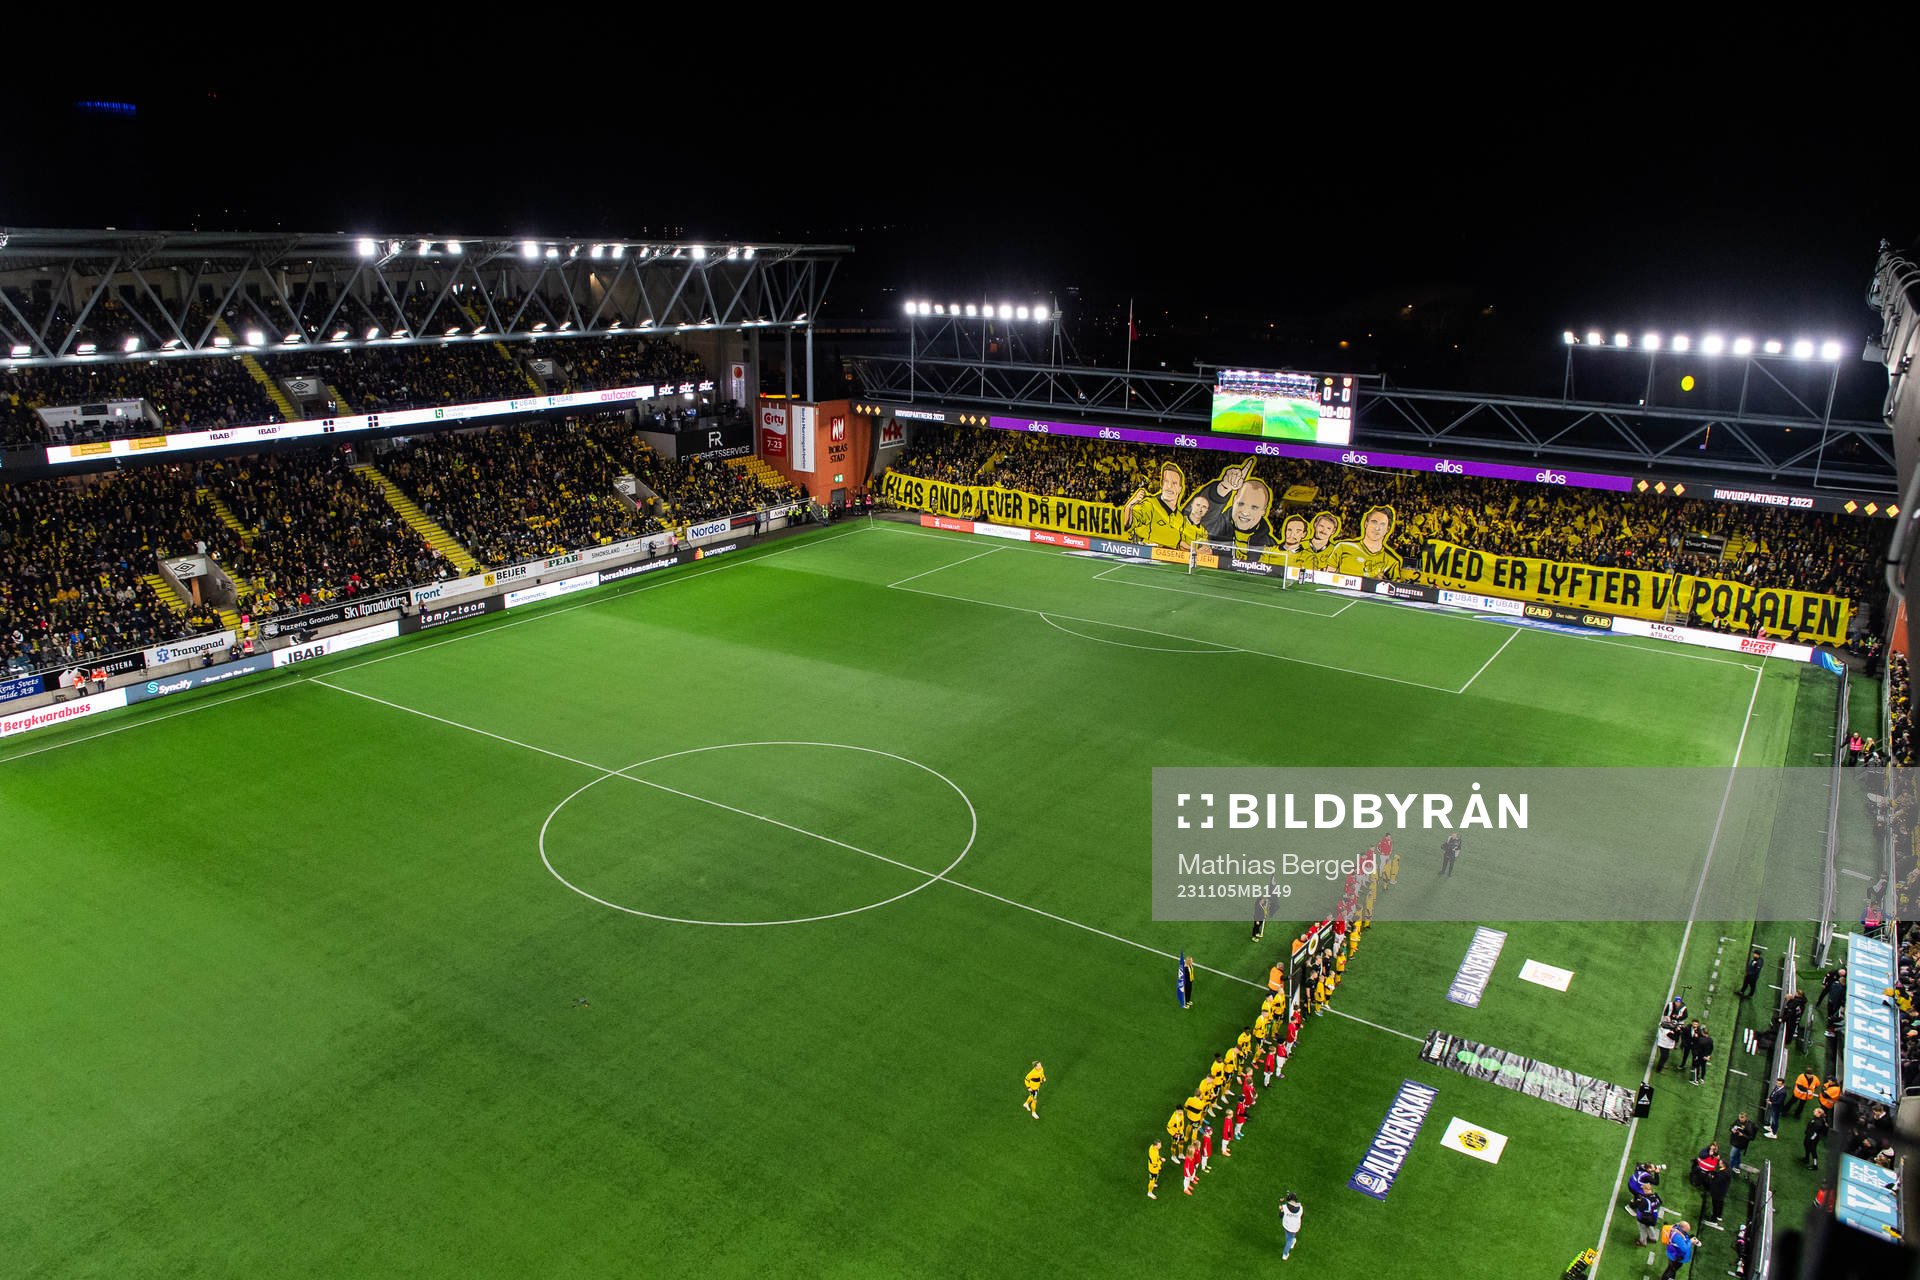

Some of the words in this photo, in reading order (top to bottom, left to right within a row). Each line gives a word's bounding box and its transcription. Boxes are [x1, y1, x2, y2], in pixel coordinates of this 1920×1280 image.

[764, 412, 784, 426] City
[883, 418, 903, 442] MAX
[1028, 421, 1048, 432] ellos
[1099, 427, 1120, 440] ellos
[1174, 434, 1197, 447] ellos
[1255, 443, 1279, 455] ellos
[830, 454, 845, 463] STAD
[1341, 451, 1368, 464] ellos
[1435, 459, 1463, 474] ellos
[1536, 470, 1566, 484] ellos
[885, 475, 924, 506] KLAS
[978, 489, 1022, 520] LEVER
[1028, 496, 1050, 525] PÅ
[1056, 501, 1122, 535] PLANEN
[1790, 497, 1813, 508] 2023
[692, 523, 726, 538] Nordea
[1101, 542, 1140, 556] TÅNGEN
[549, 553, 578, 568] PEAB
[496, 566, 526, 580] BEIJER
[415, 588, 440, 602] front
[1424, 543, 1484, 582] MED
[1493, 559, 1527, 591] ER
[1537, 563, 1640, 608] LYFTER
[1693, 580, 1842, 637] POKALEN
[1527, 607, 1550, 618] EAB
[1585, 616, 1609, 627] EAB
[1651, 624, 1674, 633] LKQ
[170, 638, 225, 658] Tranpenad
[288, 645, 325, 663] IBAB
[4, 703, 91, 732] Bergkvarabuss
[1362, 1083, 1437, 1181] ALLSVENSKAN
